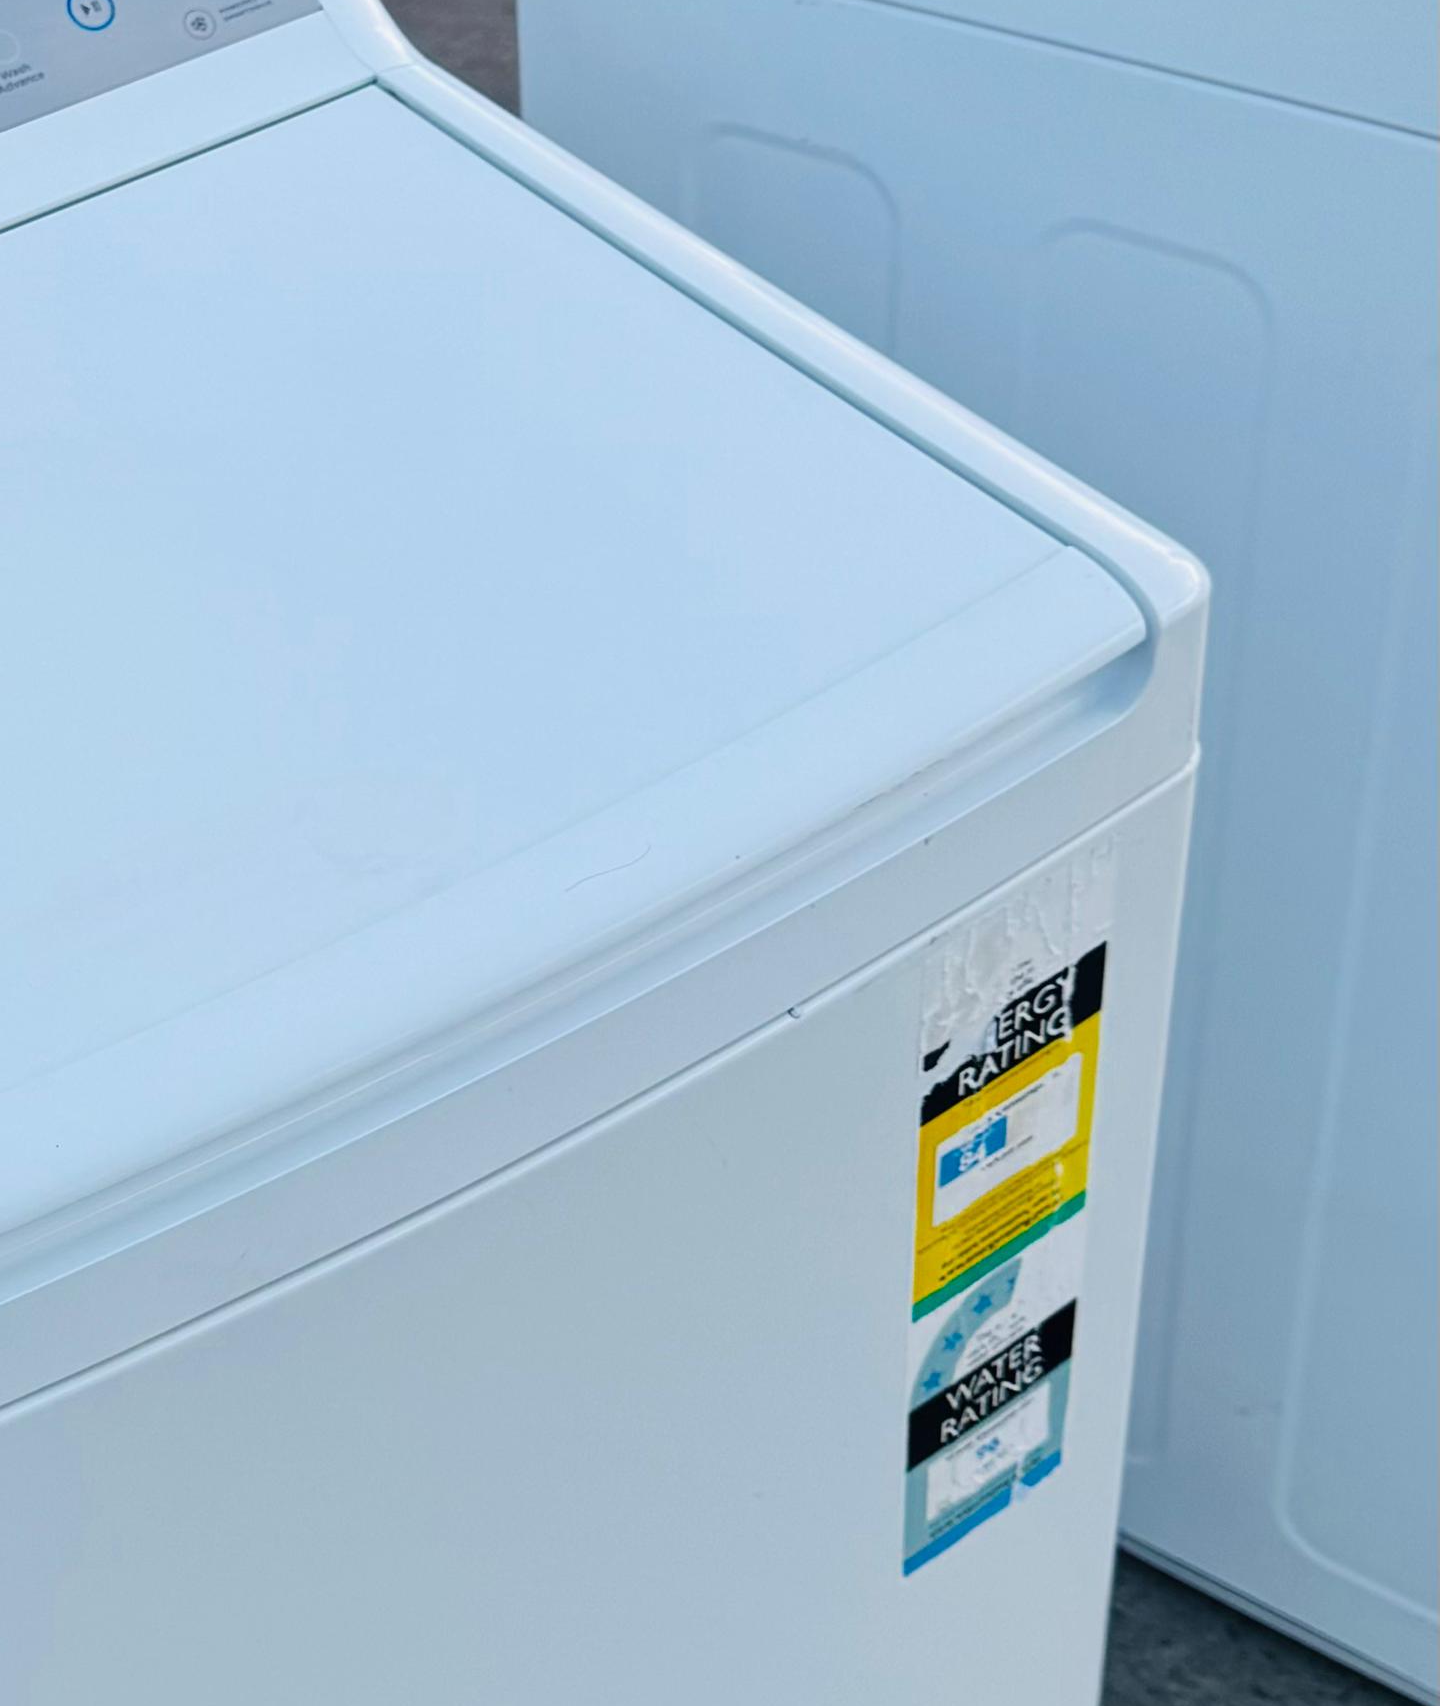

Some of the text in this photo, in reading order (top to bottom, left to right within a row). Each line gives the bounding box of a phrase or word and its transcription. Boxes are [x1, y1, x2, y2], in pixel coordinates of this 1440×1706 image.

[957, 1005, 1073, 1096] RATING
[940, 1356, 1045, 1444] RATING
[945, 1334, 1042, 1411] WATER
